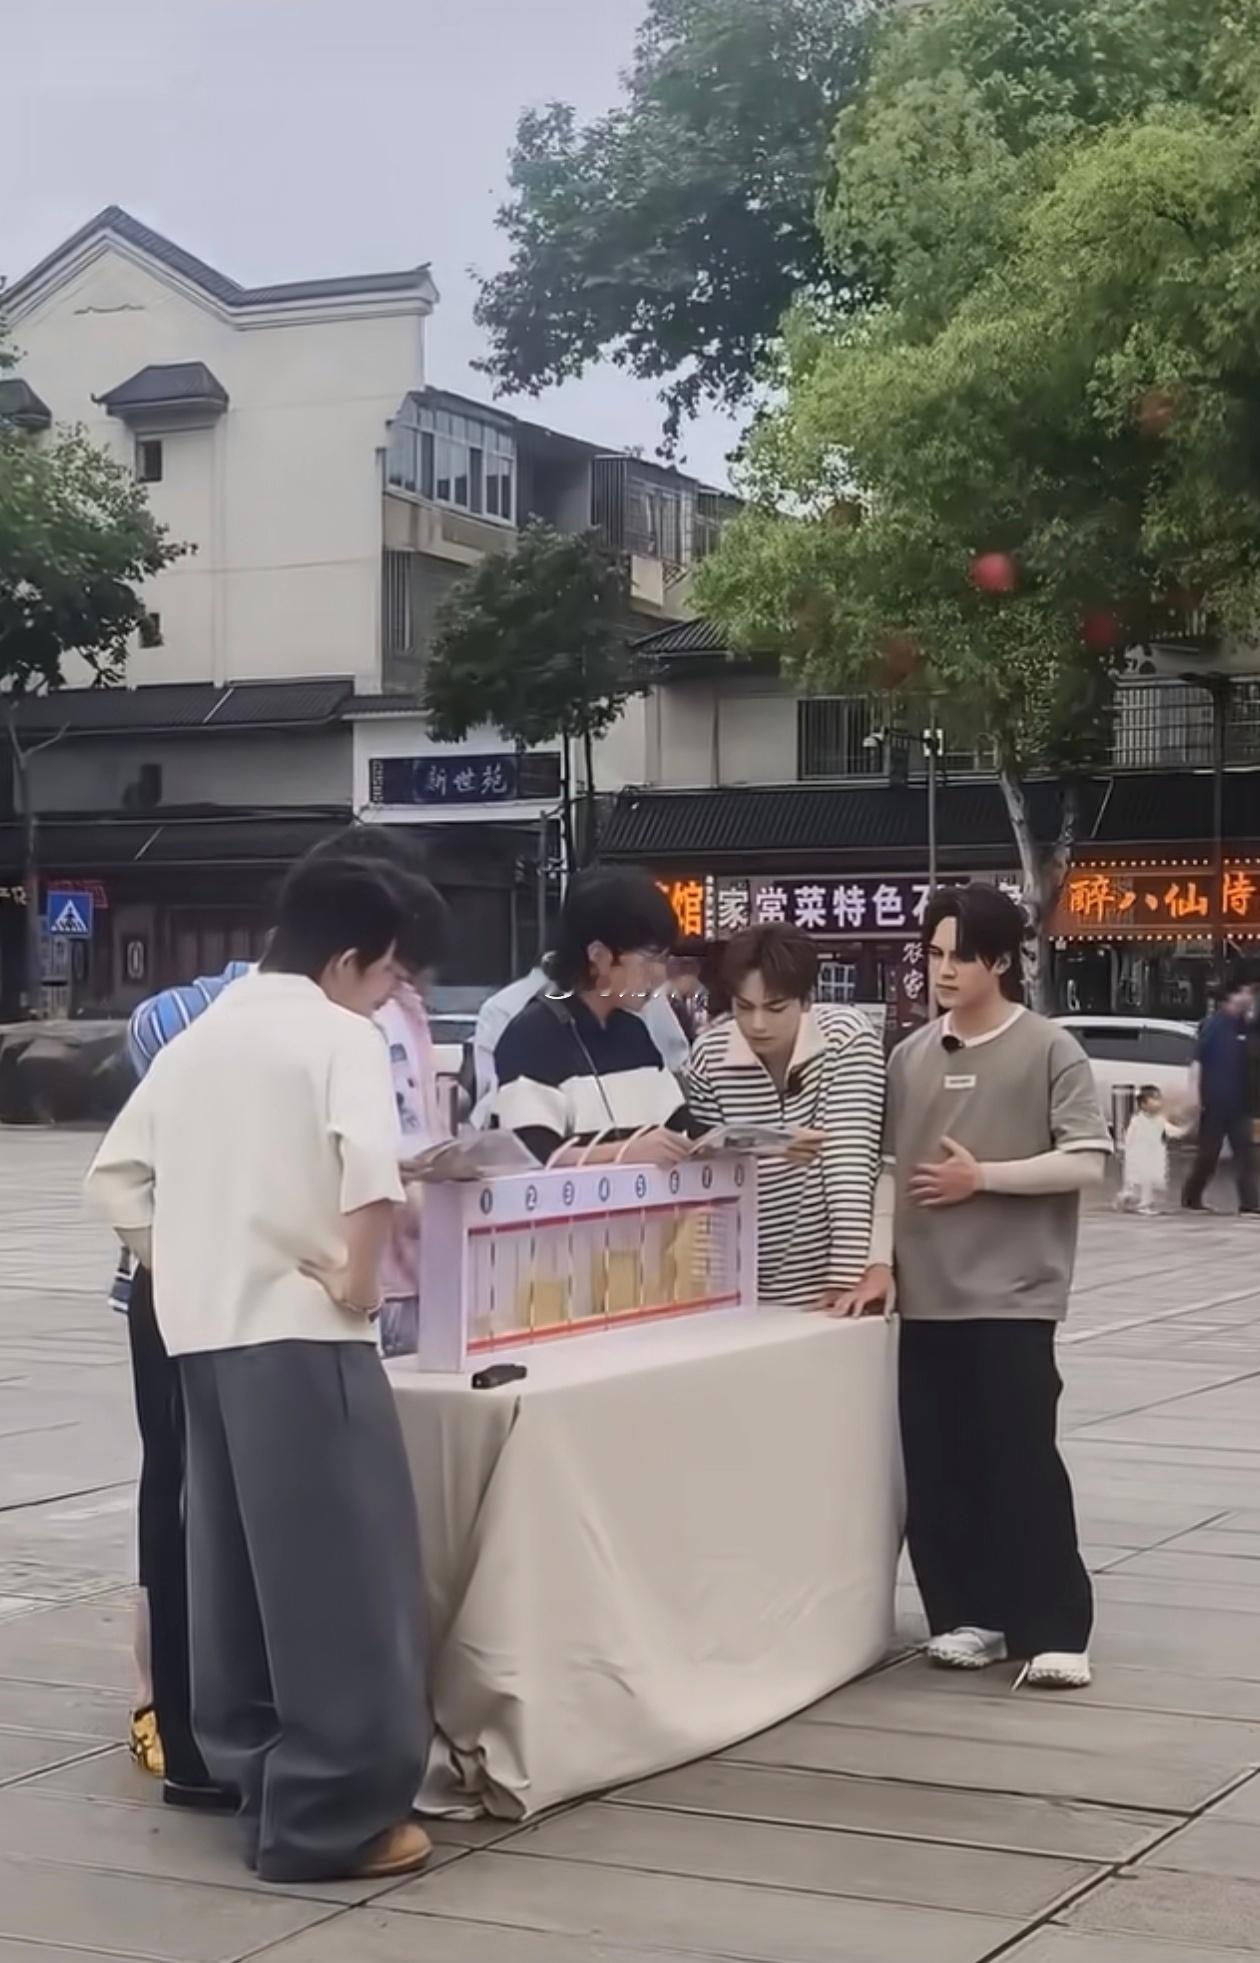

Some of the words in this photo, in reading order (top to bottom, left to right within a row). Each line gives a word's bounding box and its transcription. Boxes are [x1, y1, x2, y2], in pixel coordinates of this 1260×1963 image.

[424, 762, 508, 796] 新世苑
[655, 881, 703, 936] 馆
